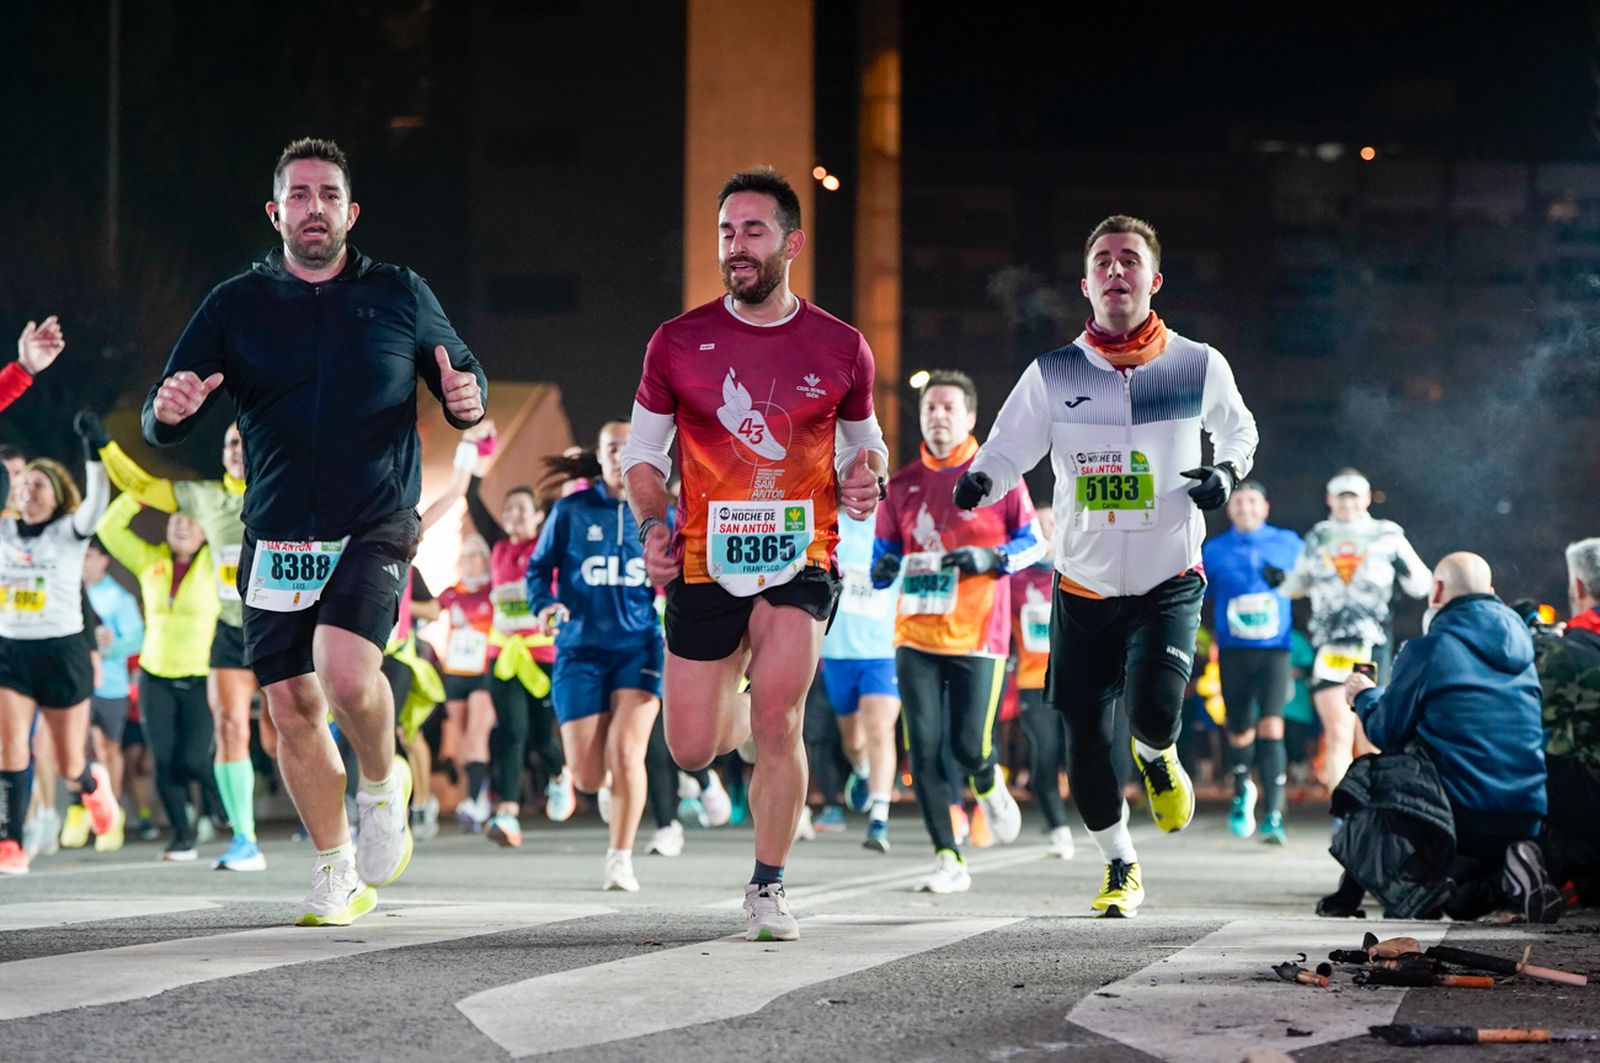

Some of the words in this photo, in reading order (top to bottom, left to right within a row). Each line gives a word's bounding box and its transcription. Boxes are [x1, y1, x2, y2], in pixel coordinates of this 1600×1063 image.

[738, 417, 764, 445] 43
[1112, 454, 1122, 462] DE
[1095, 463, 1122, 474] NTÓN
[754, 480, 775, 489] SAN
[1086, 475, 1139, 502] 5133
[731, 512, 762, 521] NOCHE
[764, 512, 776, 521] DE
[720, 523, 739, 533] SAN
[742, 521, 776, 533] ANTÓN
[726, 535, 796, 564] 8365
[271, 553, 331, 581] 8388
[743, 565, 780, 573] FRANCISCO
